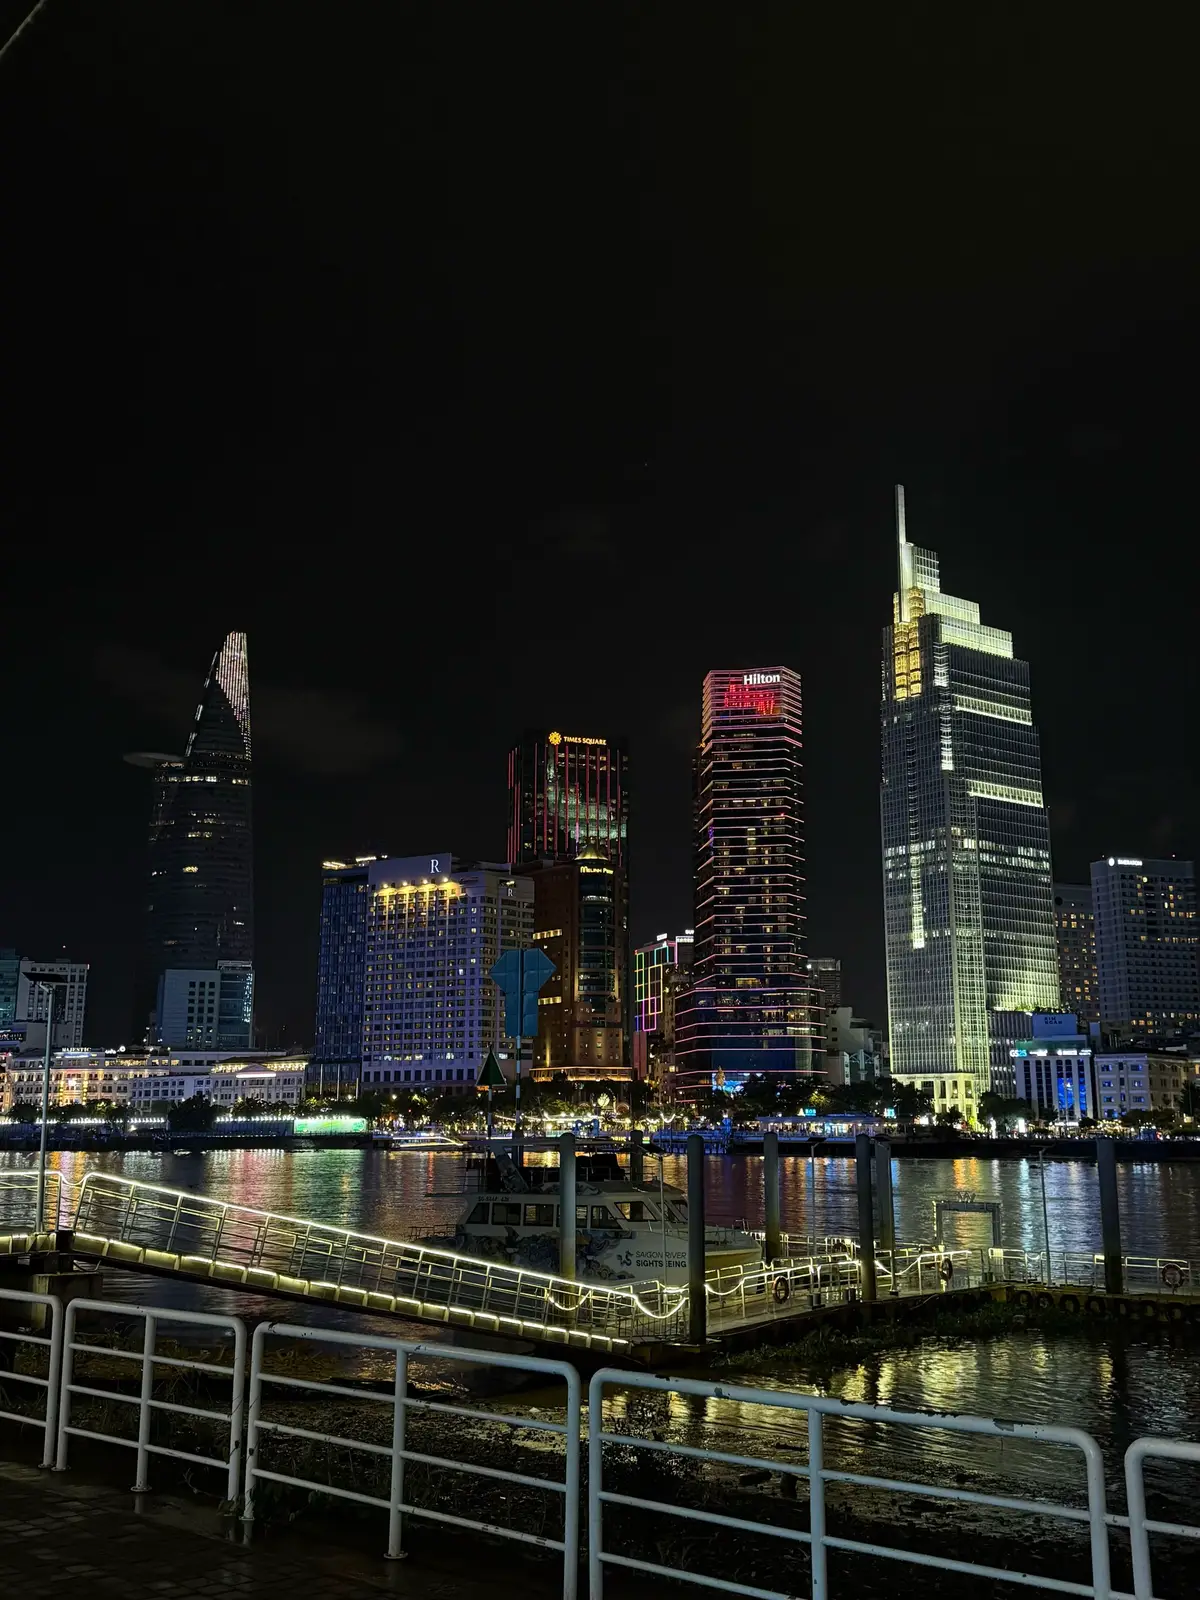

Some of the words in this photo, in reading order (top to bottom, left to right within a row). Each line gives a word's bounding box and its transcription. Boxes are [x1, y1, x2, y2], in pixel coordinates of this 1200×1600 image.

[743, 673, 781, 686] Hilton
[563, 736, 582, 744] TIMES
[582, 737, 607, 746] SQUARE
[430, 858, 442, 874] R
[507, 887, 514, 897] R
[1009, 1049, 1028, 1058] GS25
[635, 1251, 664, 1259] SAIGON
[665, 1251, 688, 1260] RIVER
